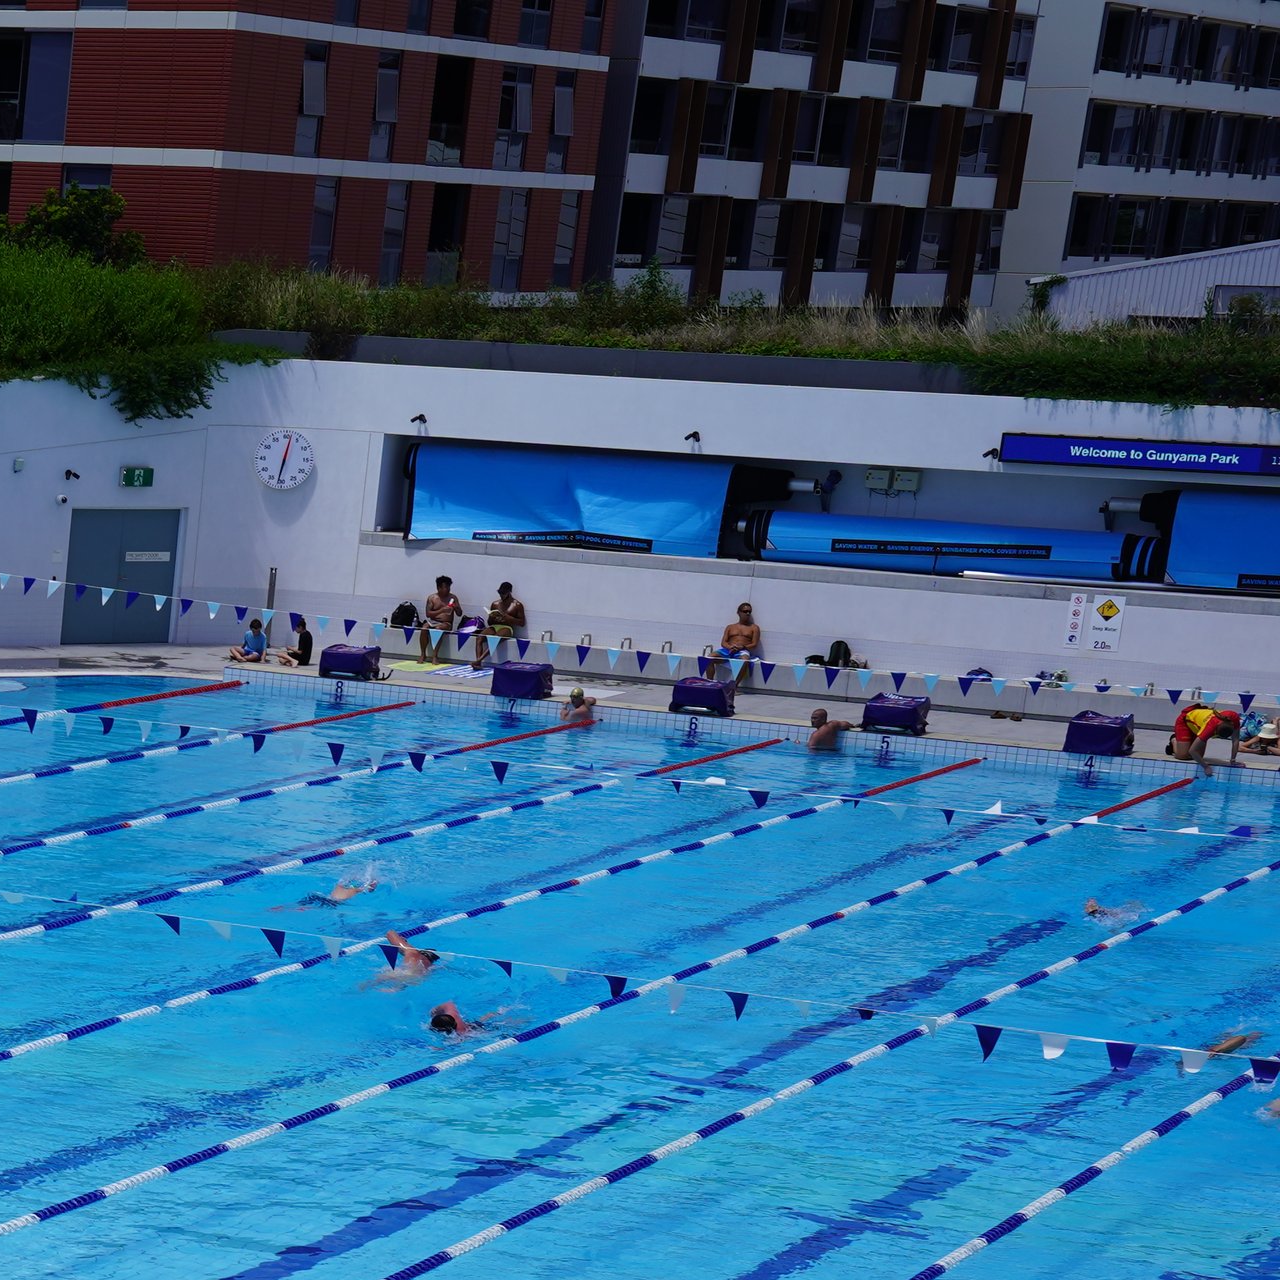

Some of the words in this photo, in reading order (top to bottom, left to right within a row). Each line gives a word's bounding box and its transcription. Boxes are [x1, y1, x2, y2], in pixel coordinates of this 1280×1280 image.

[1070, 446, 1127, 459] Welcome
[1130, 450, 1142, 460] to
[1146, 450, 1206, 464] Gunyama
[1210, 453, 1240, 465] Park
[1093, 640, 1111, 649] 2.0m
[335, 680, 344, 693] 8
[508, 698, 516, 712] 7
[689, 716, 698, 730] 6
[880, 736, 890, 749] 5
[1084, 755, 1095, 769] 4
